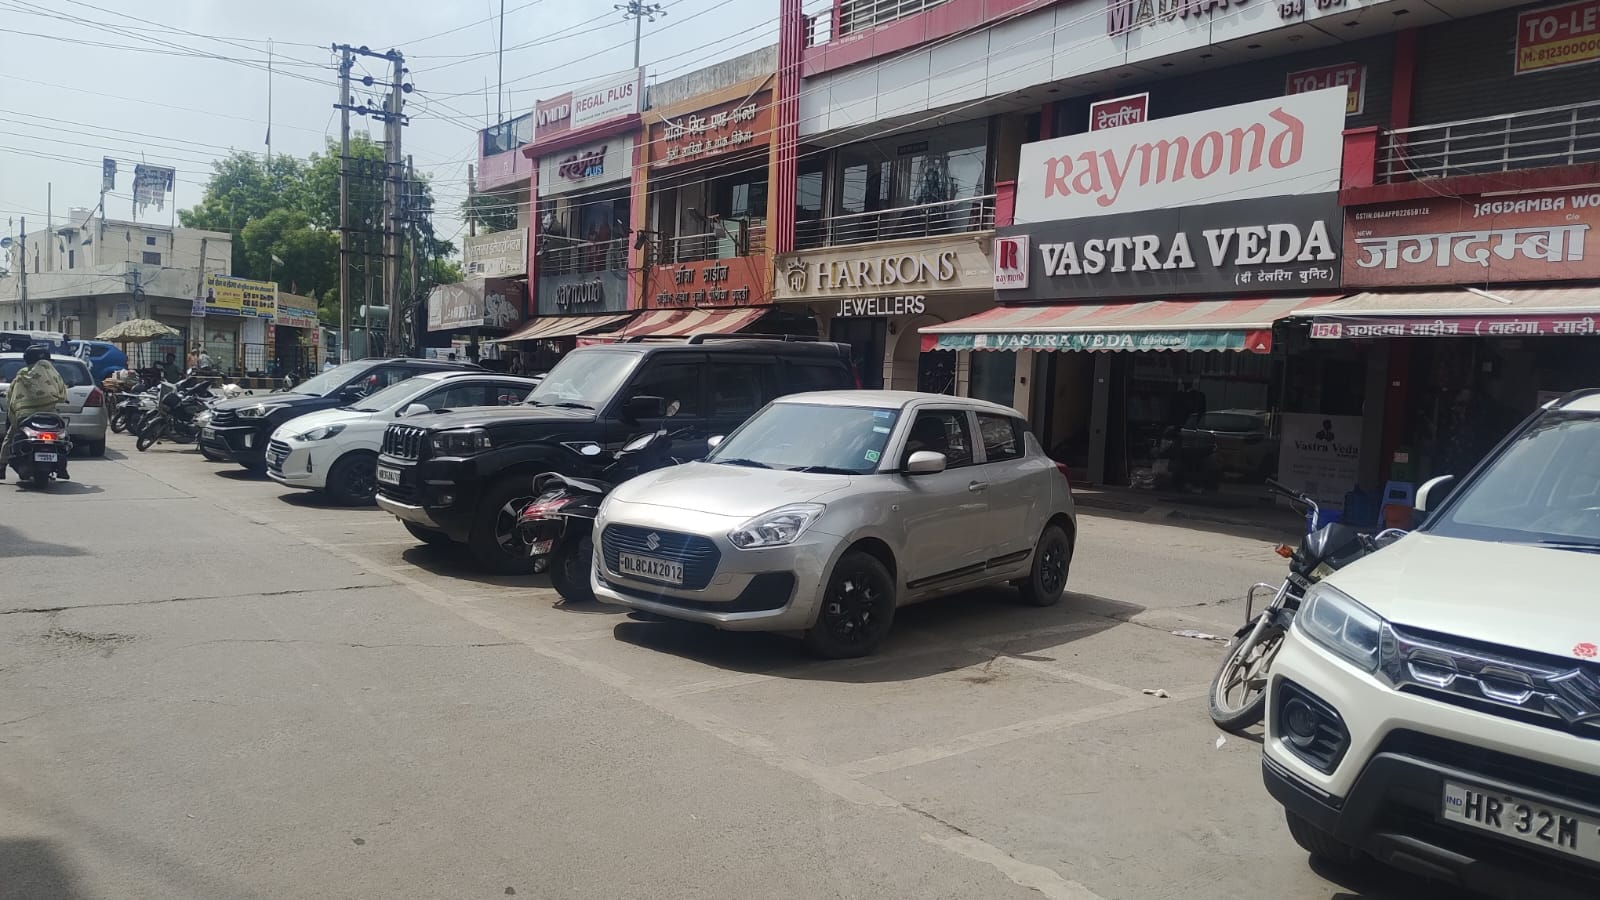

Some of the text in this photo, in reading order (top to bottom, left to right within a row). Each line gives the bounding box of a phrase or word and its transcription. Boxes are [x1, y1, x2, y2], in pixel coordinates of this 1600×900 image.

[1526, 6, 1600, 42] TO-LE
[576, 93, 604, 113] REGAL
[608, 84, 632, 102] PLUS
[585, 164, 602, 177] PLUS
[1473, 197, 1565, 218] JAGDAMBA
[1039, 220, 1336, 276] VASTRA VEDA
[1354, 223, 1591, 269] जगदम्बा
[817, 251, 958, 289] HARISONS
[837, 295, 926, 317] JEWELLERS
[998, 334, 1070, 347] VASTRA
[1079, 334, 1134, 347] VEDA
[1313, 324, 1338, 336] 154
[624, 557, 682, 580] DL8CAX2012
[1446, 795, 1463, 806] IND
[1464, 790, 1503, 828] HR
